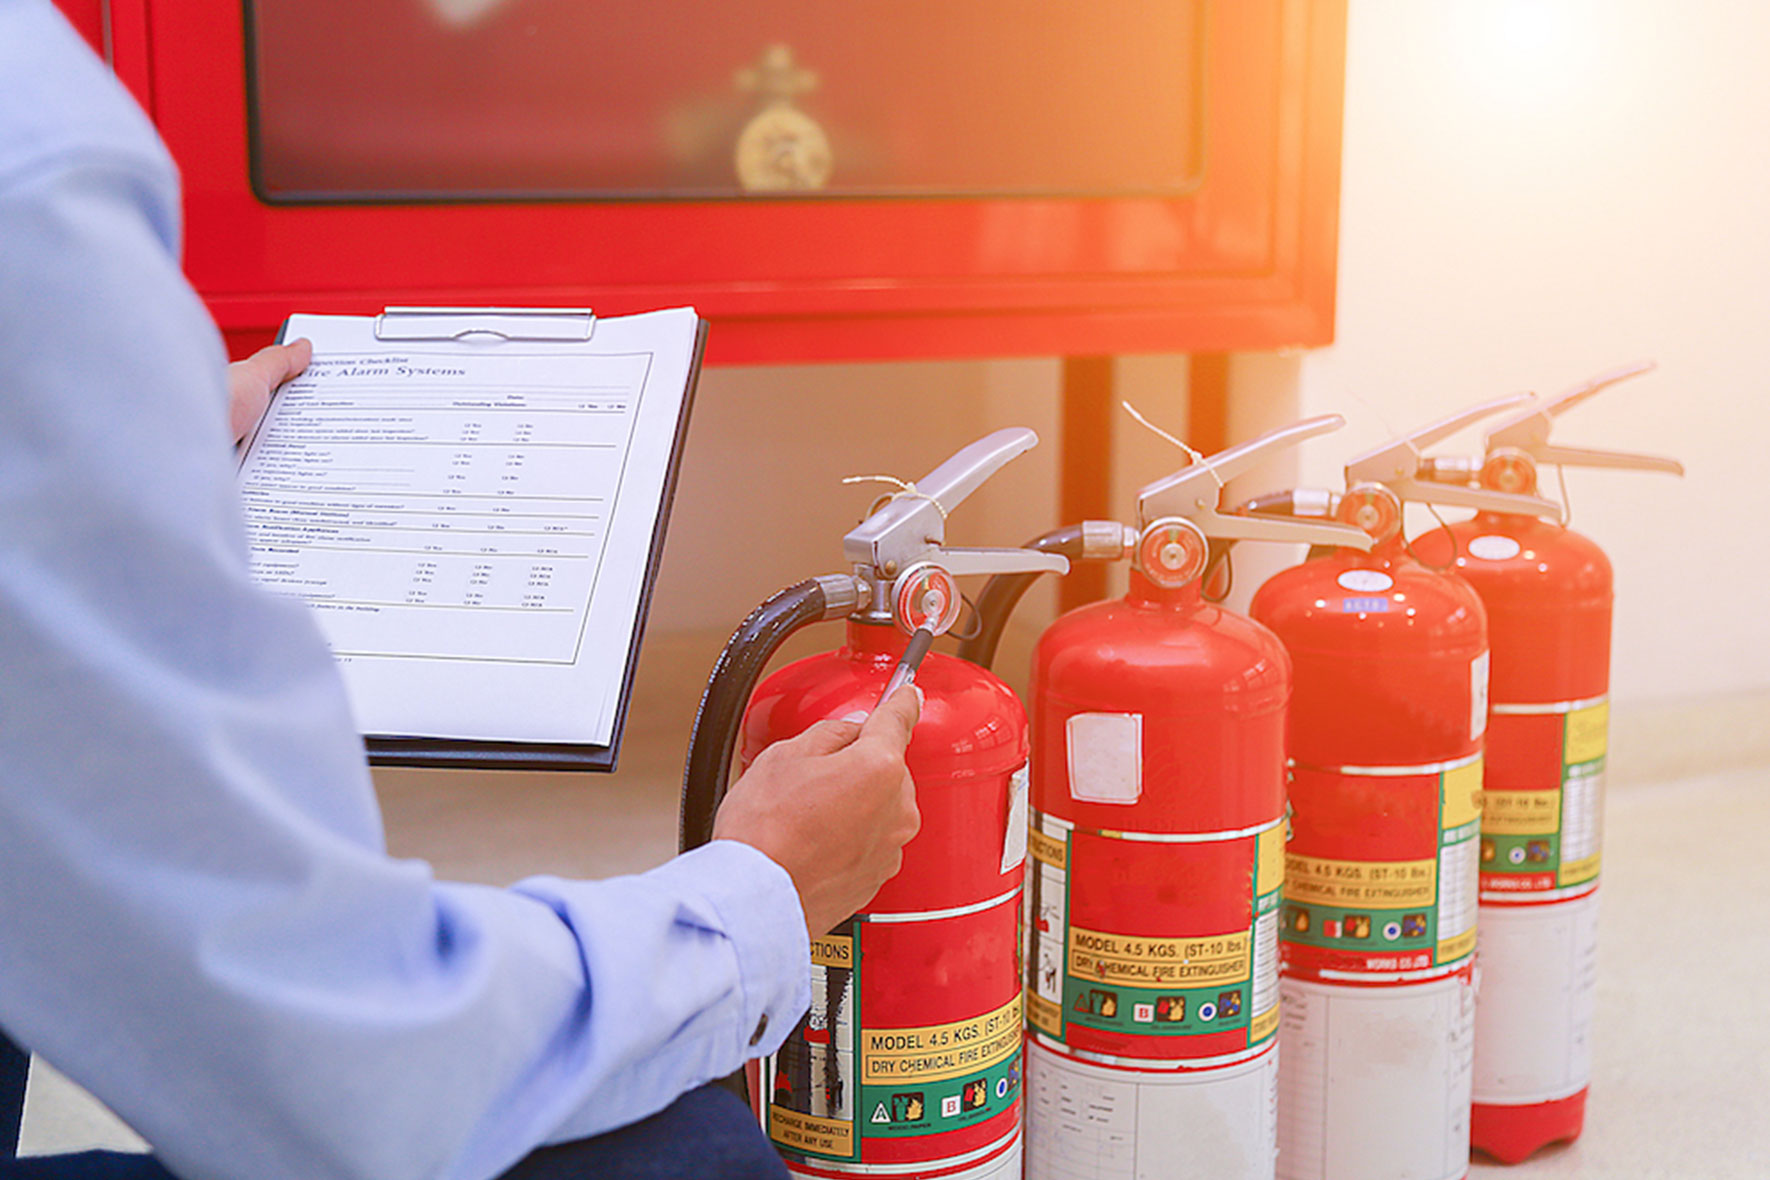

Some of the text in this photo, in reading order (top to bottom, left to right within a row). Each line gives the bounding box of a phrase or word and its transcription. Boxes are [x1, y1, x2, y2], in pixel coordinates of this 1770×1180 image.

[336, 366, 390, 377] Alarm
[395, 364, 466, 378] Systems
[1075, 933, 1119, 954] MODEL
[1124, 942, 1143, 955] 4.5
[1184, 942, 1223, 959] (ST-10
[1076, 955, 1093, 969] DRY
[1152, 967, 1176, 979] FIRE
[1179, 959, 1244, 978] EXTINGUISHER
[870, 1034, 924, 1051] MODEL
[929, 1031, 949, 1046] 4.5
[871, 1060, 896, 1073] DRY
[899, 1056, 955, 1073] CHEMICAL
[958, 1047, 979, 1064] FIRE
